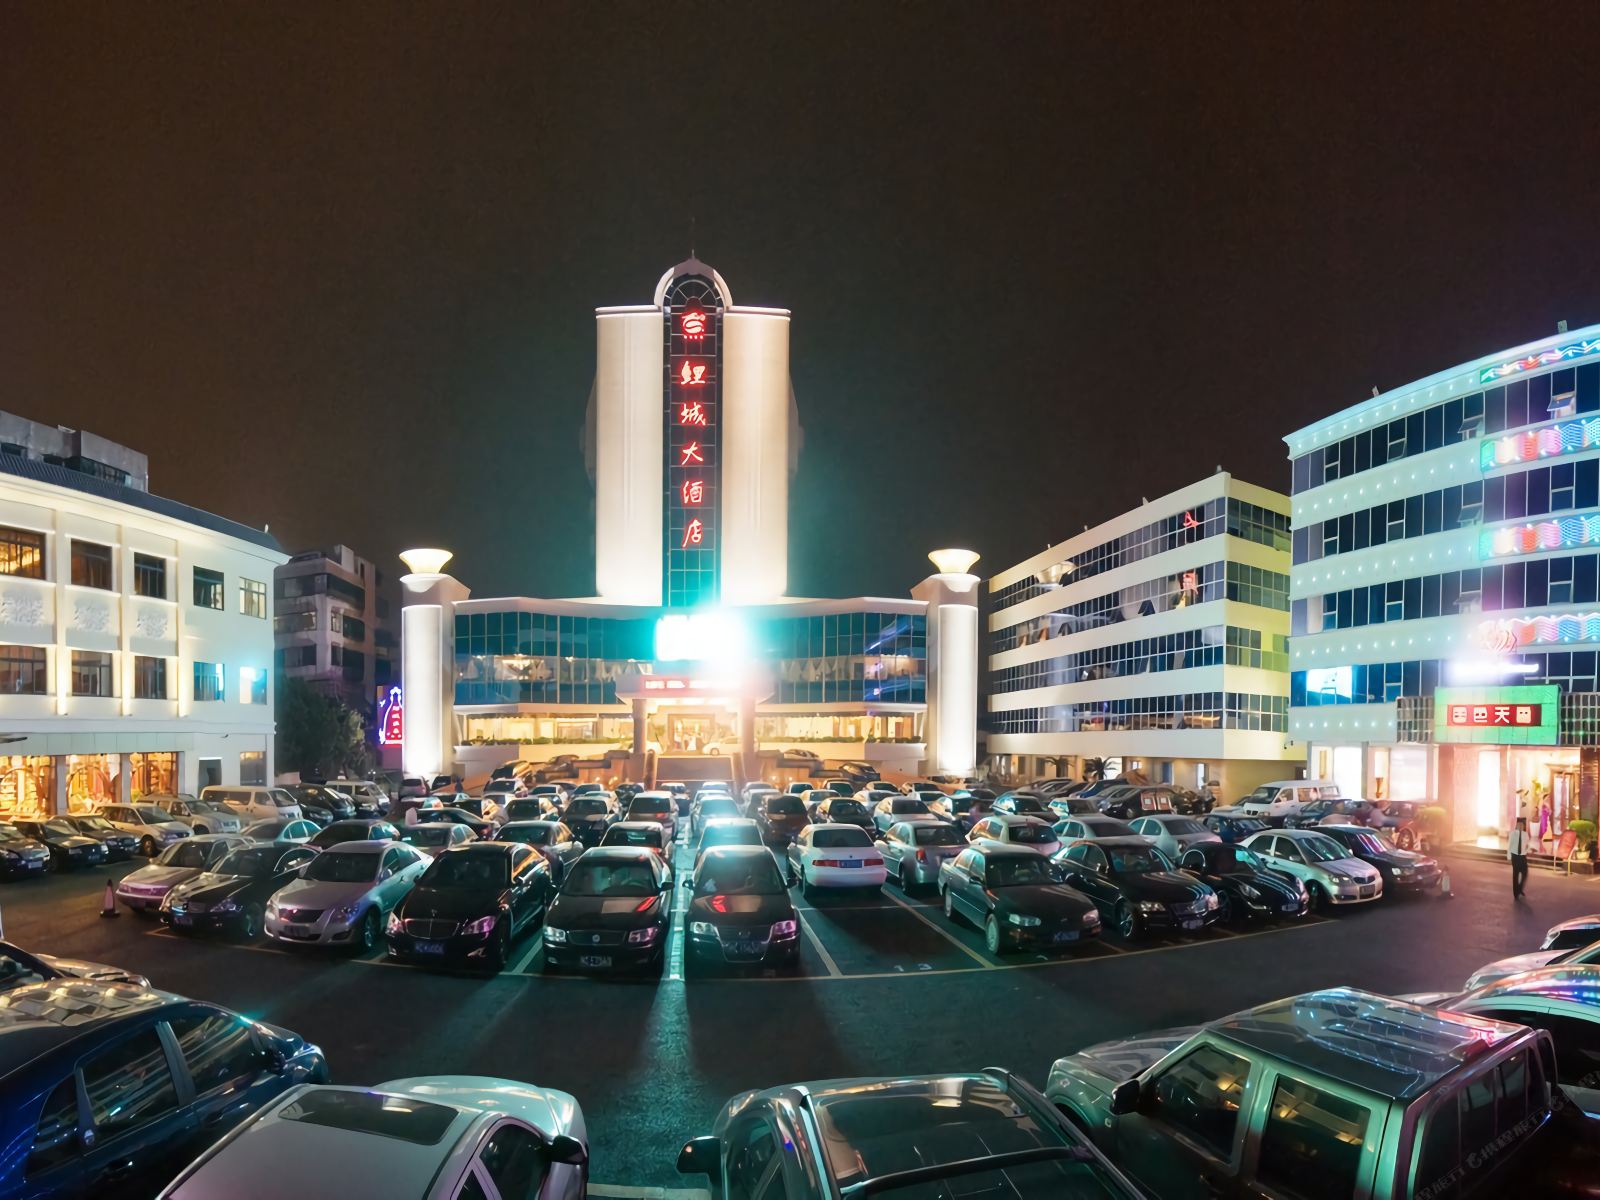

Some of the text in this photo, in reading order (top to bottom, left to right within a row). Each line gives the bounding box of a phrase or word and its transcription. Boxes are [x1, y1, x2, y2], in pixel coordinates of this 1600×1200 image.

[680, 361, 706, 547] 鲤城大酒店
